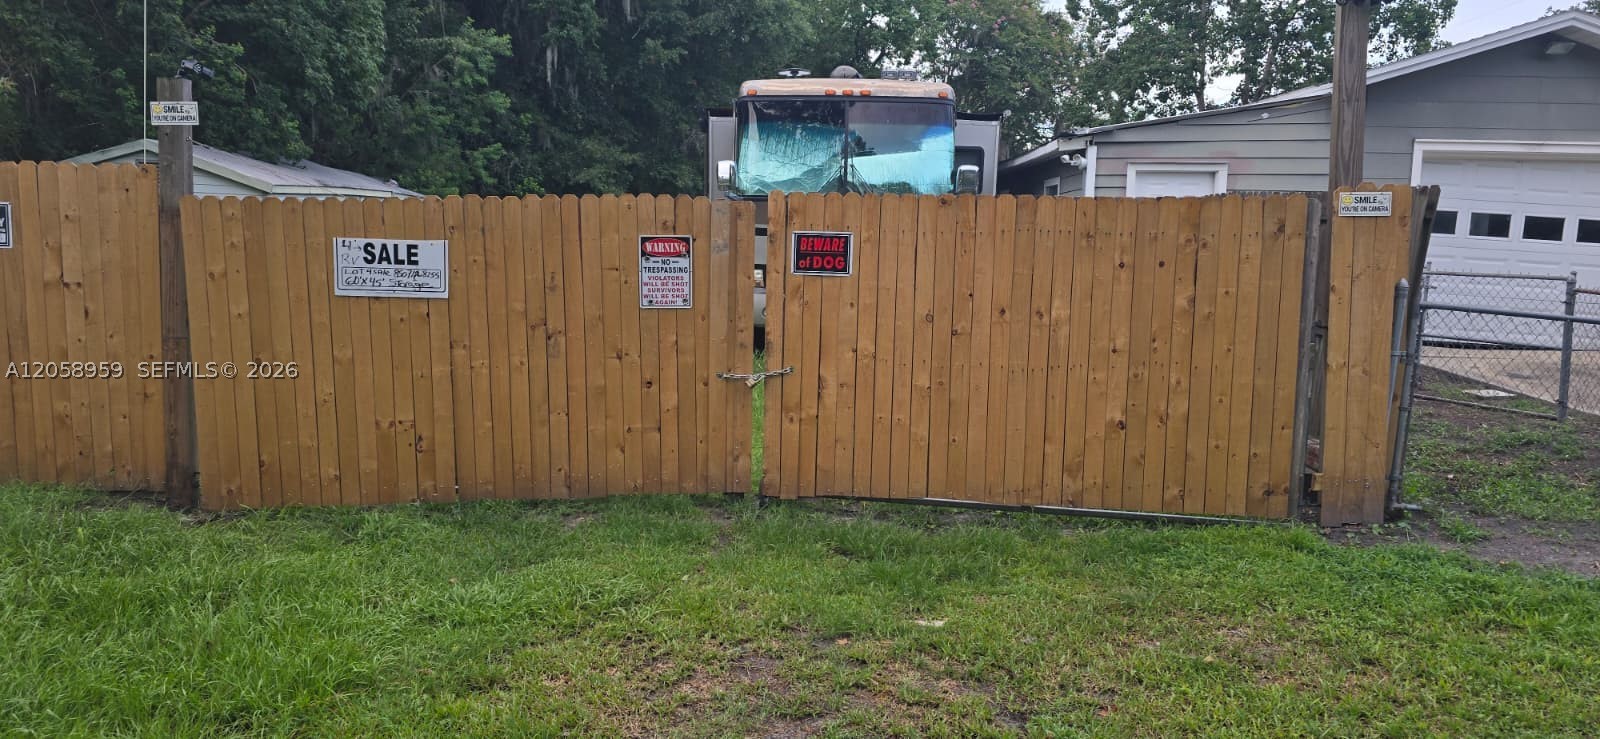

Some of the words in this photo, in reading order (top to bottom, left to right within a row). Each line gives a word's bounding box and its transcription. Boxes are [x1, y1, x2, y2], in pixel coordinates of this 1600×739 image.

[163, 105, 185, 114] SMILE
[1354, 196, 1377, 204] SMILE
[645, 242, 687, 253] WARNING
[800, 237, 846, 252] BEWARE
[363, 242, 419, 266] SALE
[799, 256, 810, 268] of
[813, 256, 846, 269] DOG
[643, 266, 689, 274] TRESPASSING
